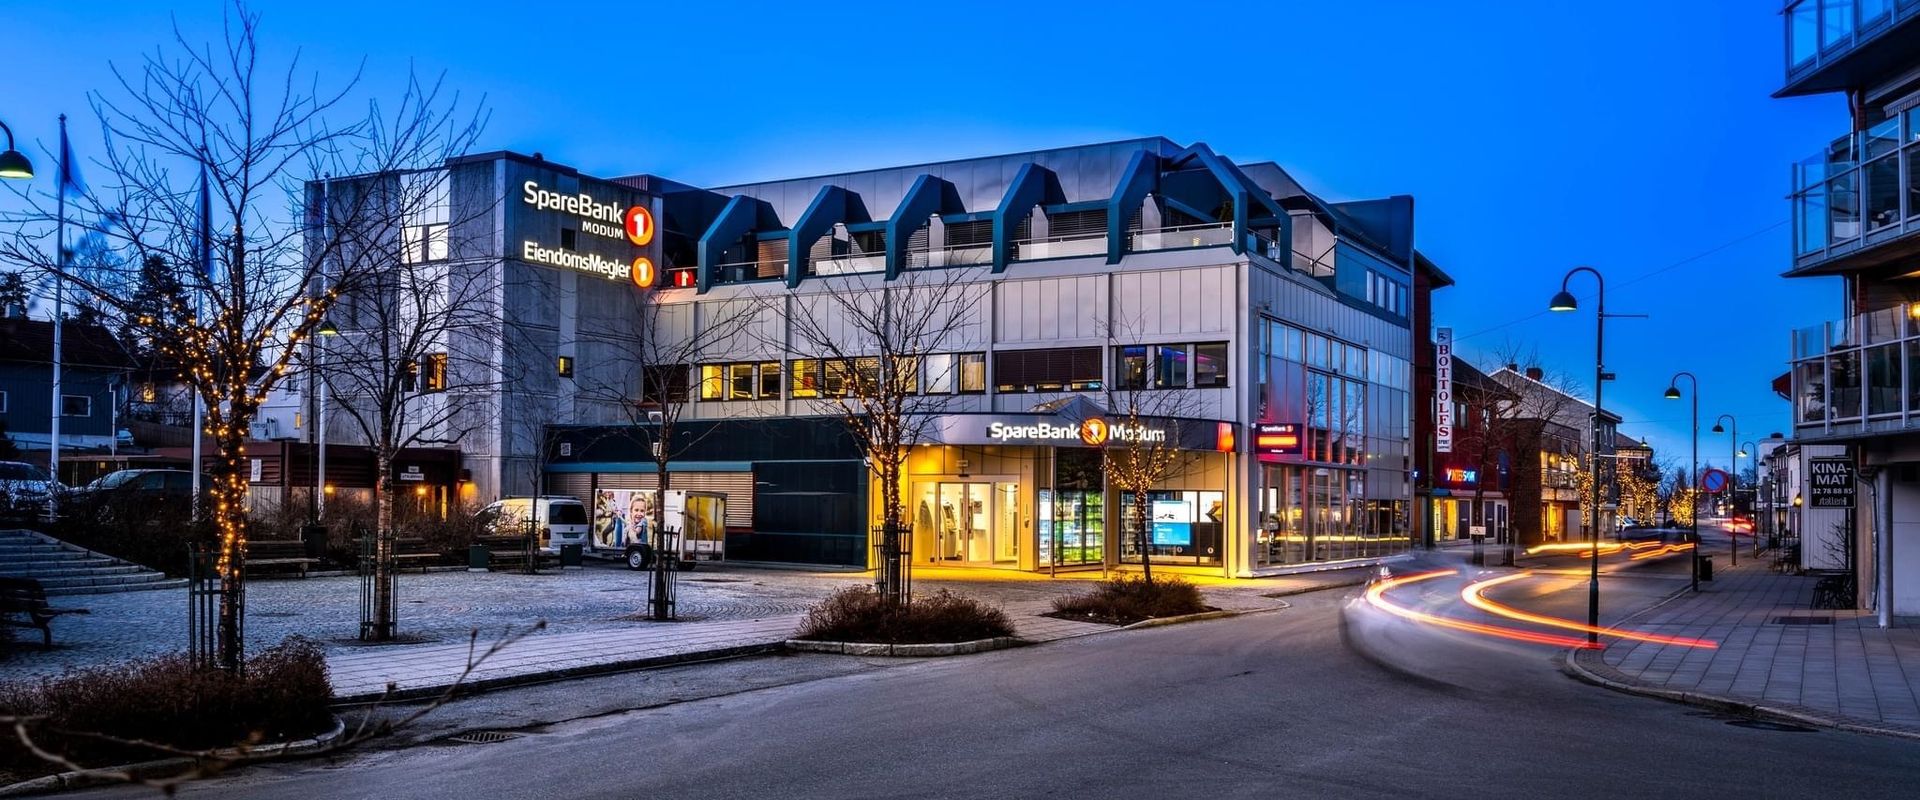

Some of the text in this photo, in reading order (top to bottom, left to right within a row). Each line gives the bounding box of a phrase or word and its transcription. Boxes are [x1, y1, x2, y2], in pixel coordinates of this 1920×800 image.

[524, 180, 623, 224] SpareBank
[582, 221, 624, 240] MODUM
[524, 241, 631, 279] EiendomsMegler
[1438, 345, 1449, 437] BOTTOLFS
[990, 422, 1080, 441] SpareBank
[1109, 423, 1166, 442] Modum
[1812, 463, 1852, 474] KINA-
[1816, 474, 1848, 485] MAT
